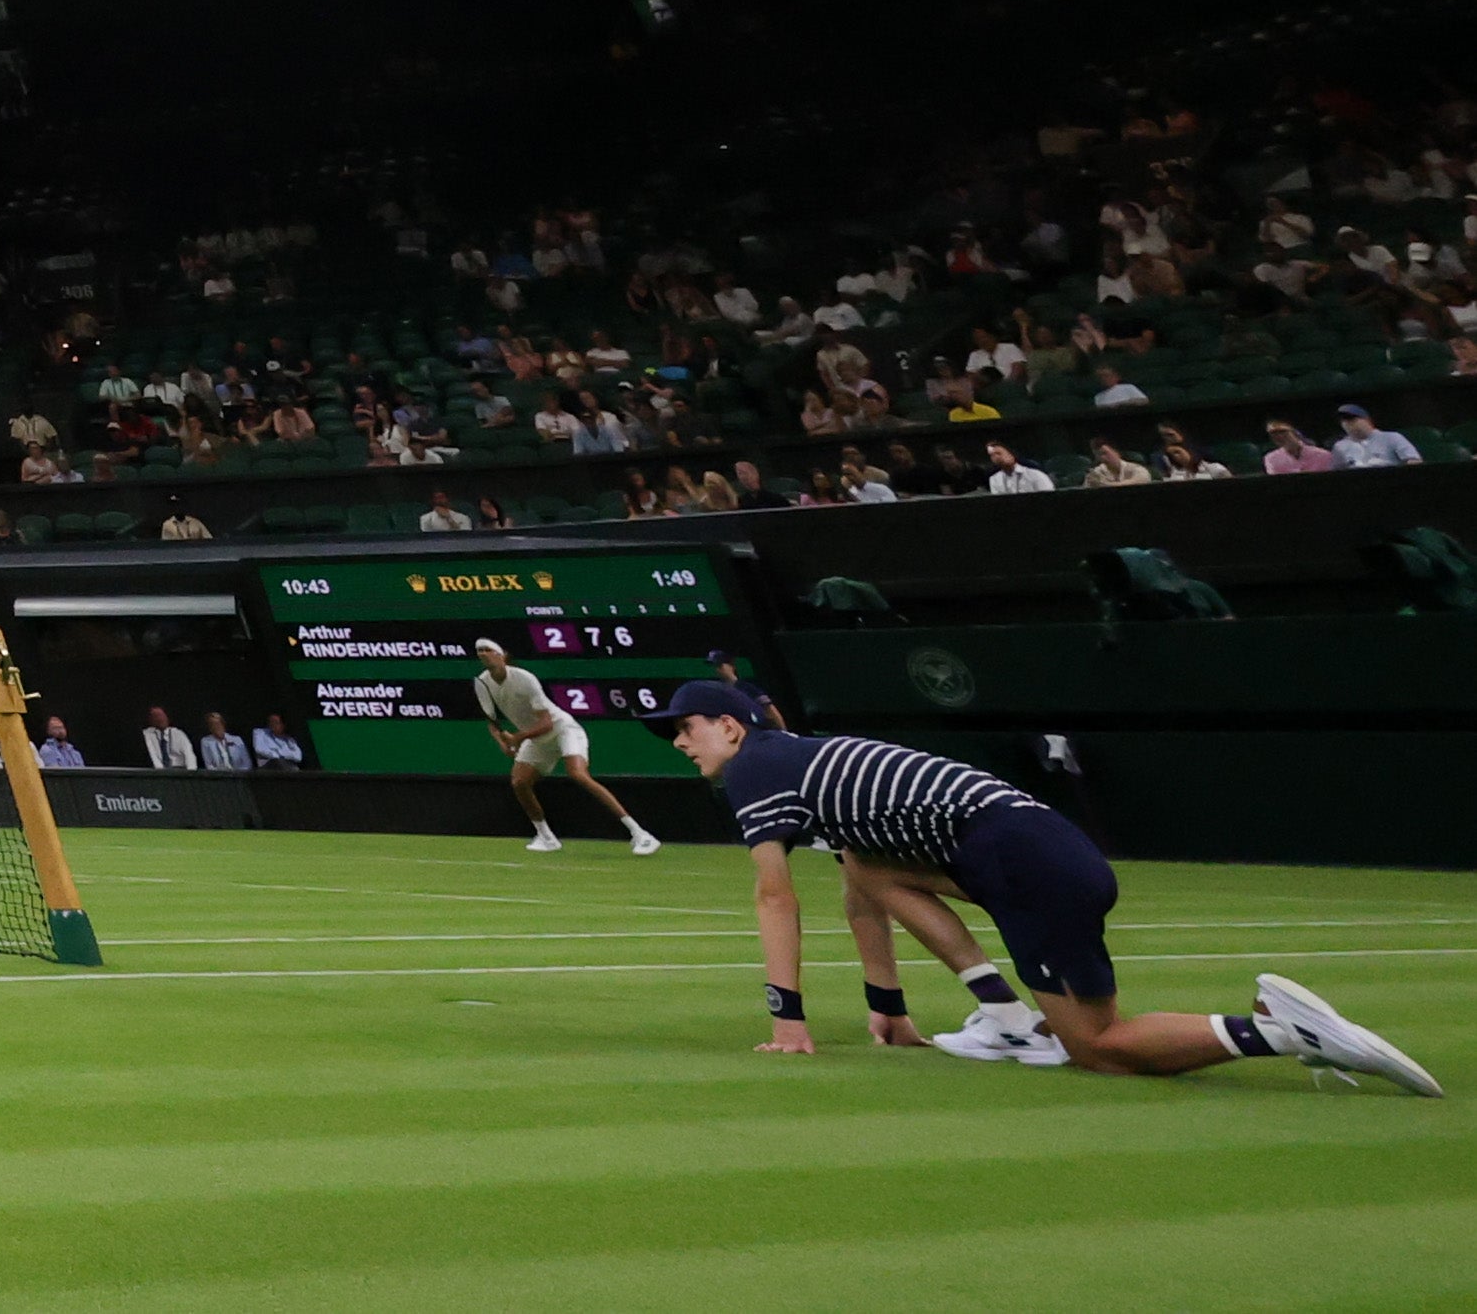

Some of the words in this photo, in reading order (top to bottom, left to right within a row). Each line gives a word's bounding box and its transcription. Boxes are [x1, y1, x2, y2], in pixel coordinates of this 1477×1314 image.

[282, 578, 331, 595] 10:43
[437, 574, 524, 592] ROLEX
[651, 569, 697, 587] 1:49
[525, 606, 564, 615] POINTS
[581, 605, 589, 614] 1
[609, 605, 617, 614] 2
[669, 604, 677, 613] 4
[298, 624, 352, 640] Arthur
[543, 627, 567, 648] 2
[584, 626, 601, 647] 7
[614, 625, 634, 648] 6
[301, 641, 437, 657] RINDERKNECH
[440, 644, 467, 656] FRA
[317, 683, 404, 698] Alexander
[566, 688, 590, 710] 2
[609, 688, 627, 709] 6
[637, 687, 658, 710] 6
[320, 701, 394, 717] ZVEREV
[399, 704, 426, 716] GER
[94, 793, 163, 812] Emirates
